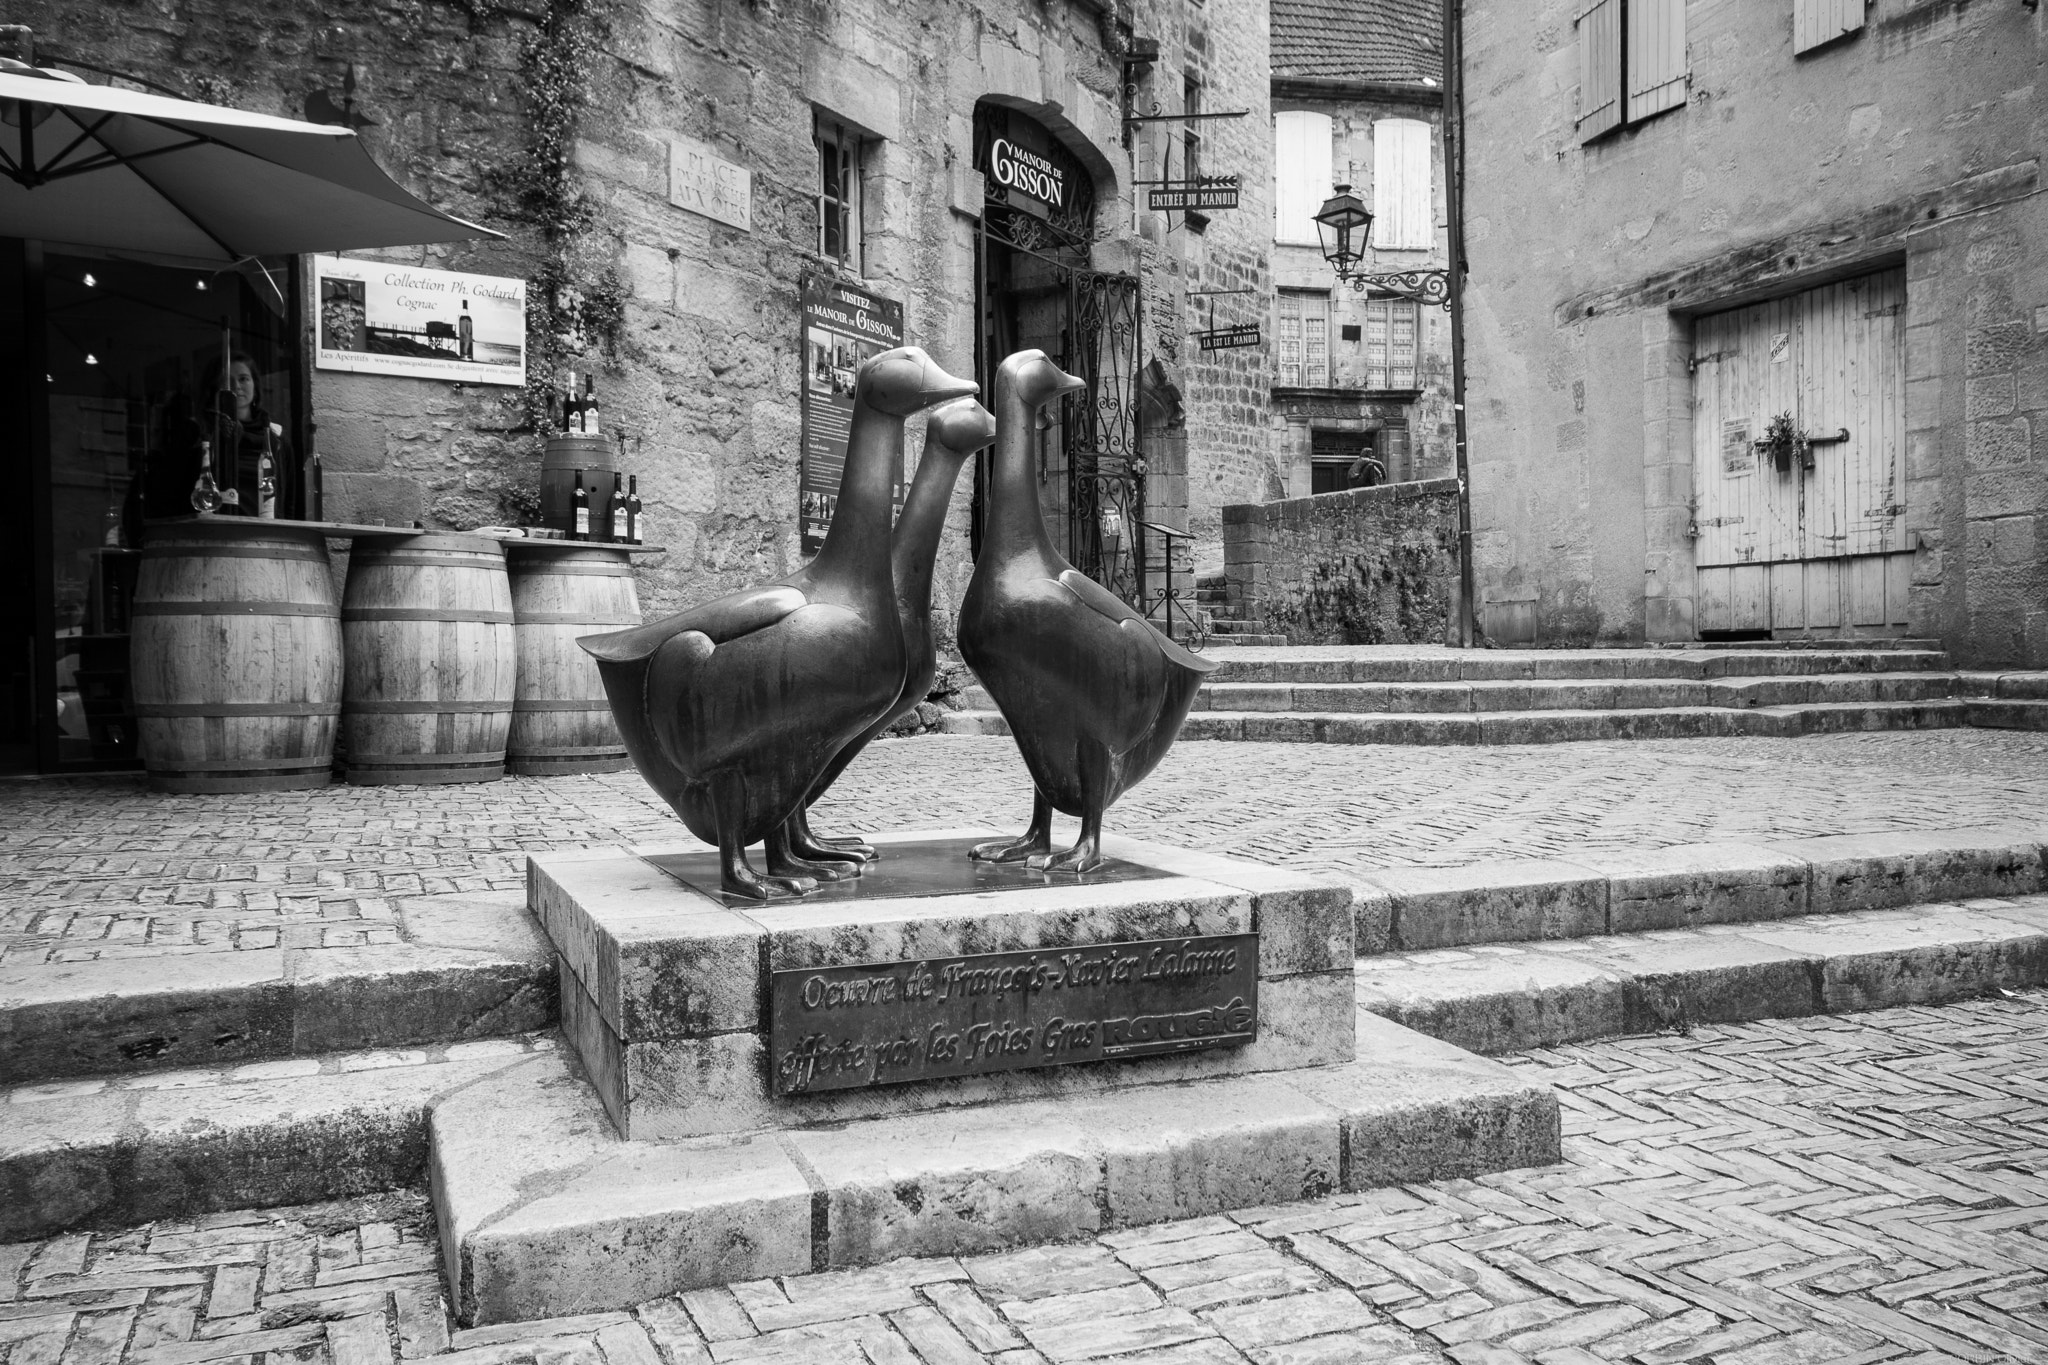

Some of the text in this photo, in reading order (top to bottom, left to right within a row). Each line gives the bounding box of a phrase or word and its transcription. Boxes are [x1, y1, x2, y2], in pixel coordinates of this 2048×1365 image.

[688, 152, 737, 187] PLACE
[992, 138, 1063, 207] GISSON
[1014, 146, 1063, 180] MANOIR DE
[711, 196, 746, 224] OIES
[1151, 192, 1237, 207] ENTRÉE DU MANOIR
[384, 273, 518, 300] Collection Ph. Godard
[840, 290, 871, 310] VISITEZ
[396, 295, 438, 311] Cognac
[807, 305, 814, 314] LE
[814, 304, 848, 325] MANOIR
[856, 309, 894, 339] GISSON
[1203, 334, 1258, 348] LA EST LE MANOIR
[320, 351, 334, 359] Les
[335, 352, 369, 362] Apéritifs
[903, 961, 935, 1002] de
[938, 949, 1139, 1004] François-Xavier
[1142, 940, 1237, 981] Lalanne
[777, 996, 1253, 1093] offerte par les Foies Gras ROUGIÉ
